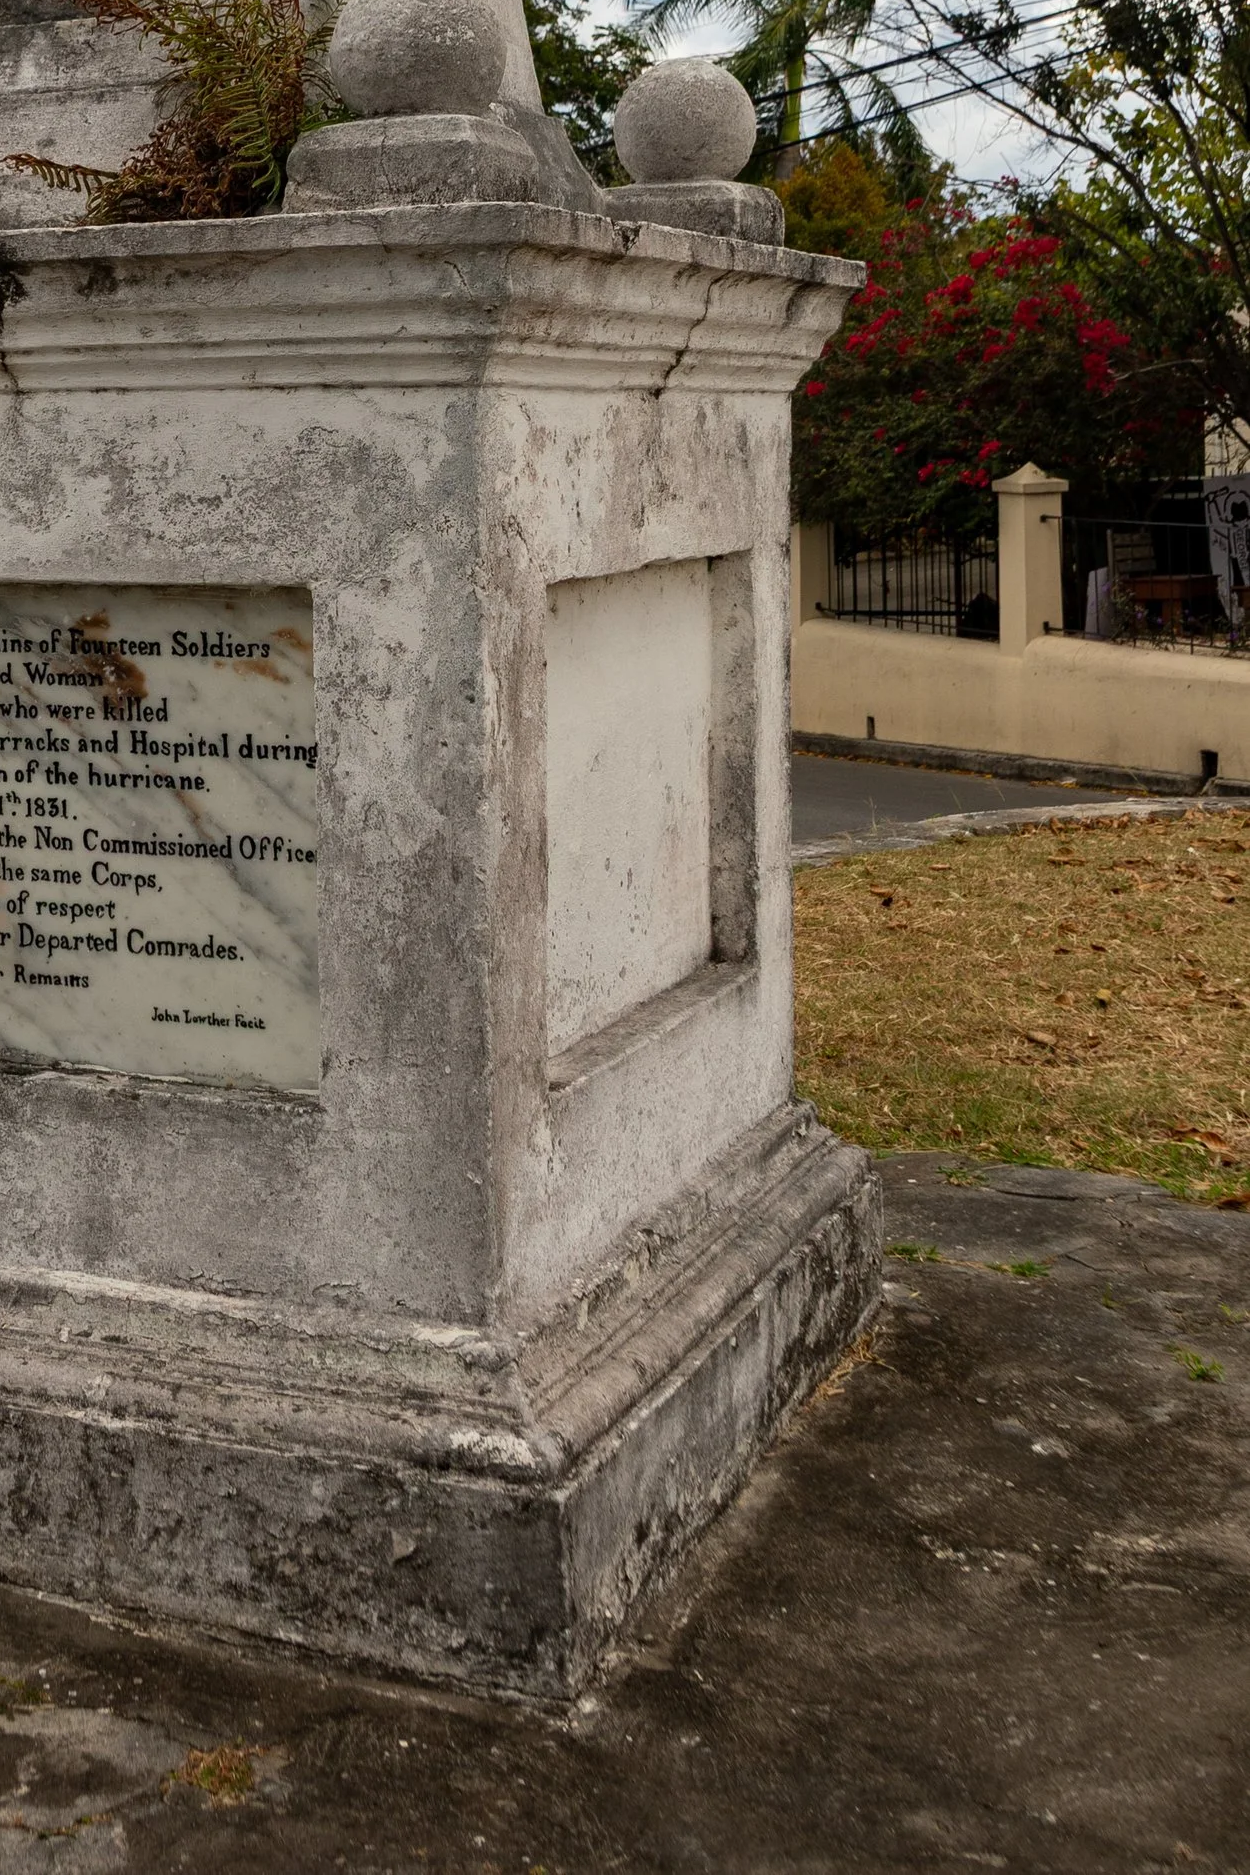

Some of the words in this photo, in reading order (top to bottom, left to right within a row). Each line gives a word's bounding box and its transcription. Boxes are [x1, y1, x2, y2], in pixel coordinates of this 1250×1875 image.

[39, 629, 61, 653] of
[69, 627, 161, 657] Fourteen
[171, 631, 270, 658] Soldiers
[23, 662, 104, 686] Woman
[46, 703, 95, 720] were
[103, 696, 168, 722] killed
[78, 730, 118, 754] and
[130, 730, 228, 763] Hospital
[239, 734, 318, 768] during
[15, 760, 39, 783] of
[45, 762, 78, 785] the
[88, 763, 210, 792] hurricane.
[25, 798, 77, 820] 1831.
[33, 826, 73, 851] Non
[83, 829, 232, 859] Commissioned
[239, 835, 318, 864] Office
[31, 866, 82, 885] same
[92, 862, 162, 894] Corps,
[7, 891, 29, 914] of
[36, 900, 116, 923] respect
[19, 923, 117, 957] Departed
[127, 929, 244, 961] Comrades.
[151, 1007, 180, 1023] John
[183, 1010, 230, 1027] Lowther
